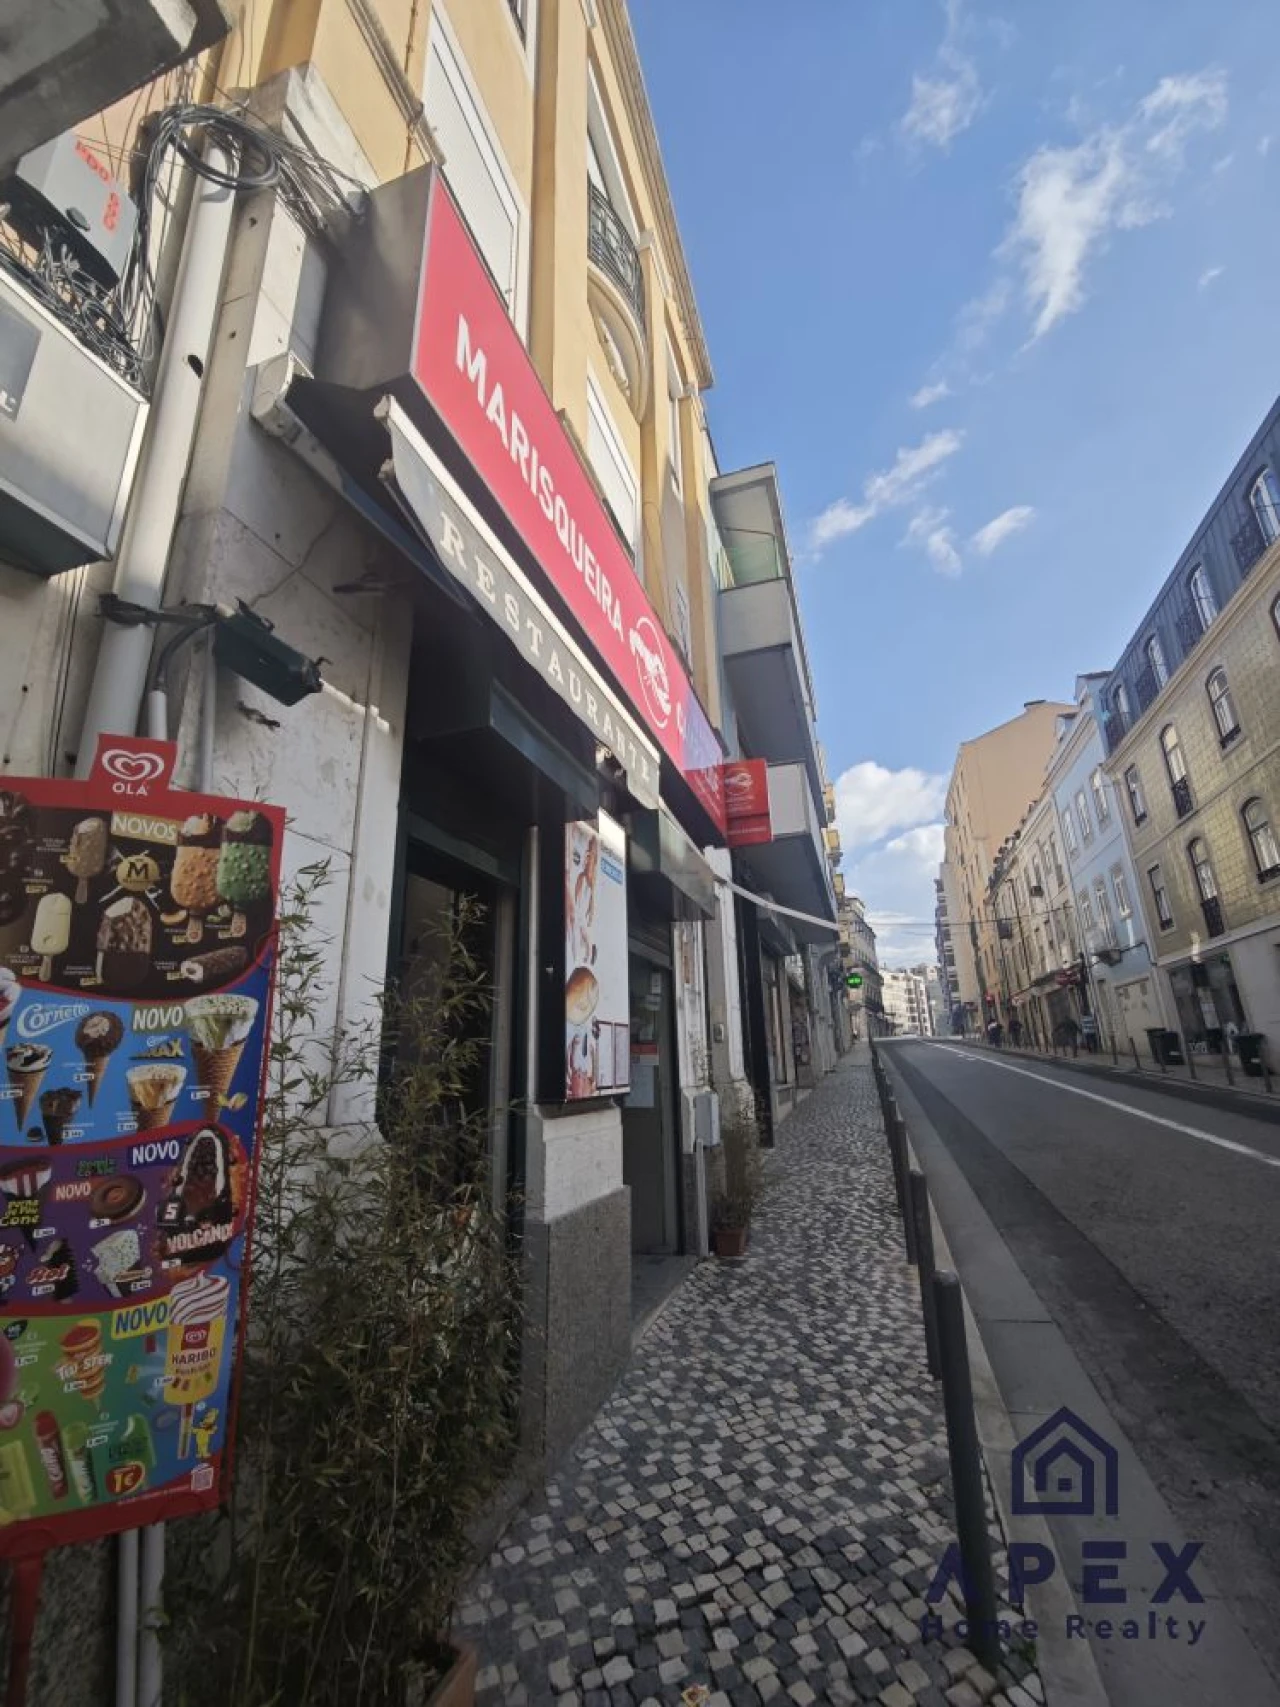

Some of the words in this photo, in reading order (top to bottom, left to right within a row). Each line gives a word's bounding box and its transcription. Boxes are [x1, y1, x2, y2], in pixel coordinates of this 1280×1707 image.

[456, 313, 624, 643] MARISQUEIRA
[440, 511, 650, 781] RESTAURANTE
[111, 814, 177, 841] NOVOS
[16, 1003, 89, 1037] Cornetto
[132, 1005, 183, 1030] NOVO
[132, 1139, 180, 1165] NOVO
[55, 1182, 91, 1200] NOVO
[115, 1301, 168, 1334] NOVO
[172, 1347, 217, 1365] HARIBO
